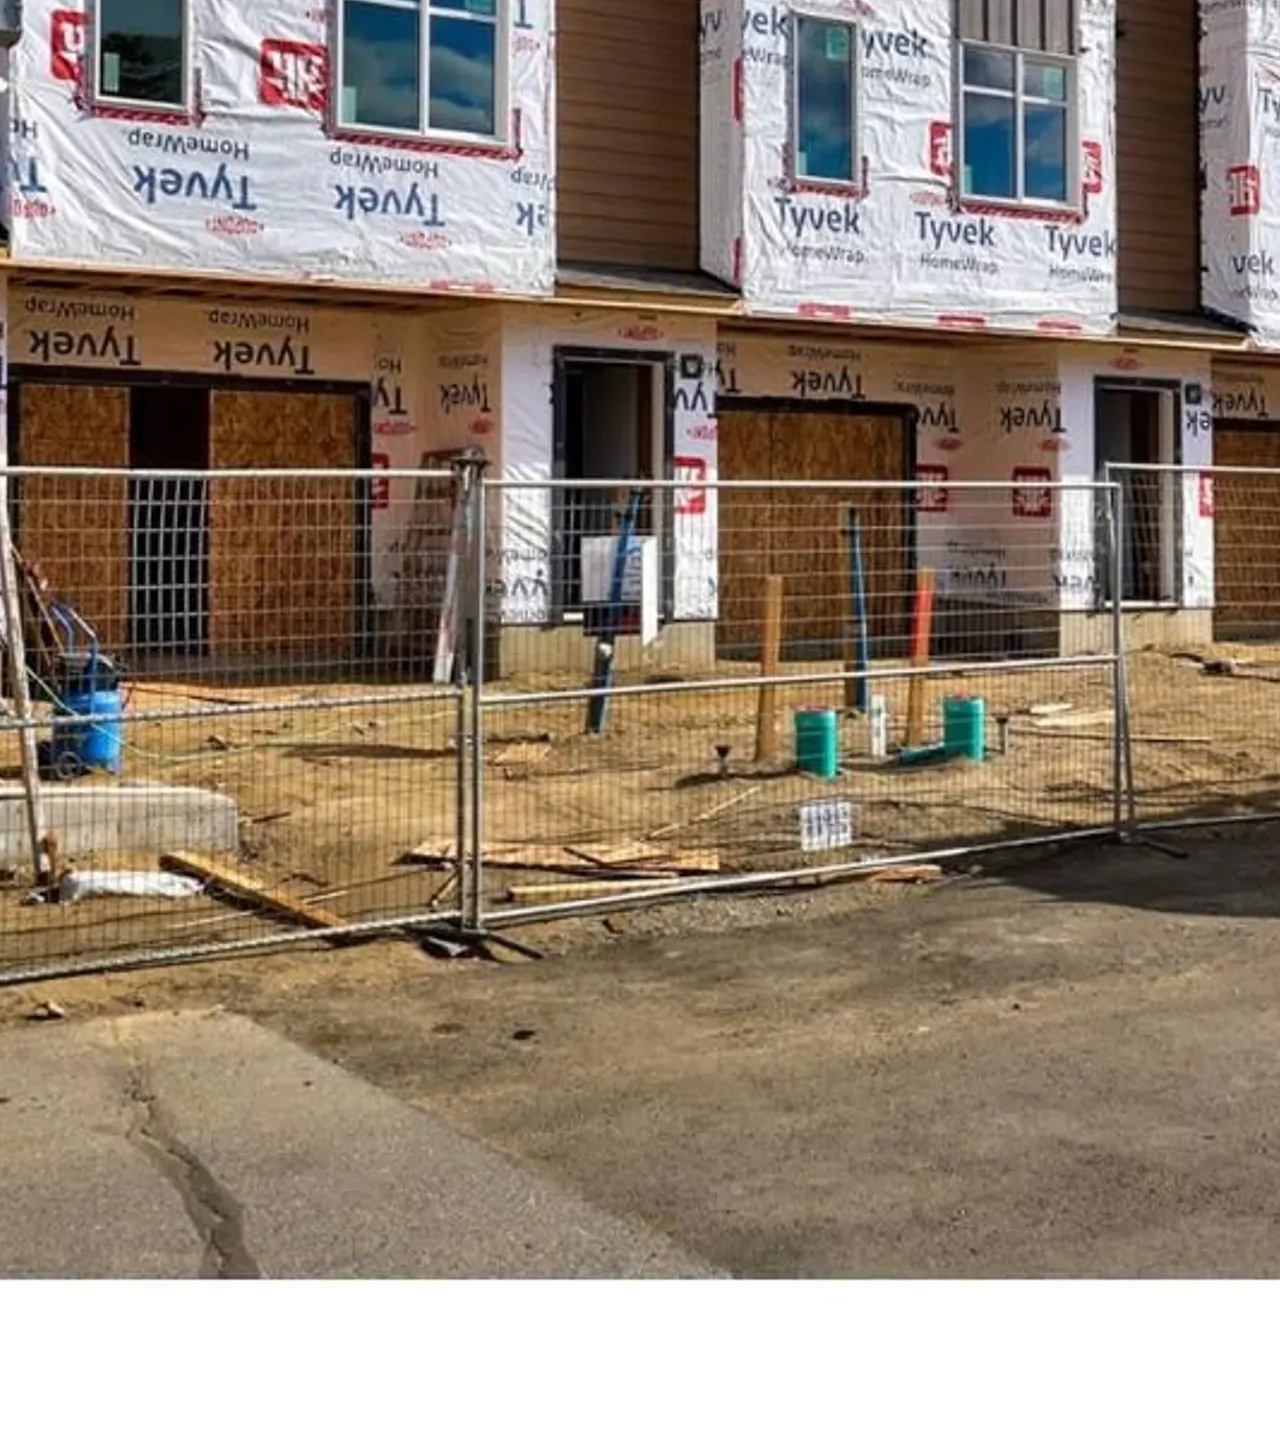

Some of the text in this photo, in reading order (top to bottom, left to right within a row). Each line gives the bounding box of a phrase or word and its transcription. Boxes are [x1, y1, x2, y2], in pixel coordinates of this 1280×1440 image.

[134, 164, 258, 210] Tyvek
[335, 182, 445, 227] Tyvek
[774, 197, 861, 234] Tyvek
[915, 212, 995, 247] Tyvek
[29, 326, 141, 366] Tyvek
[214, 336, 314, 374] Tyvek
[440, 380, 492, 414] Tyvek
[792, 370, 866, 399] Tyvek
[999, 404, 1065, 433] Tyvek
